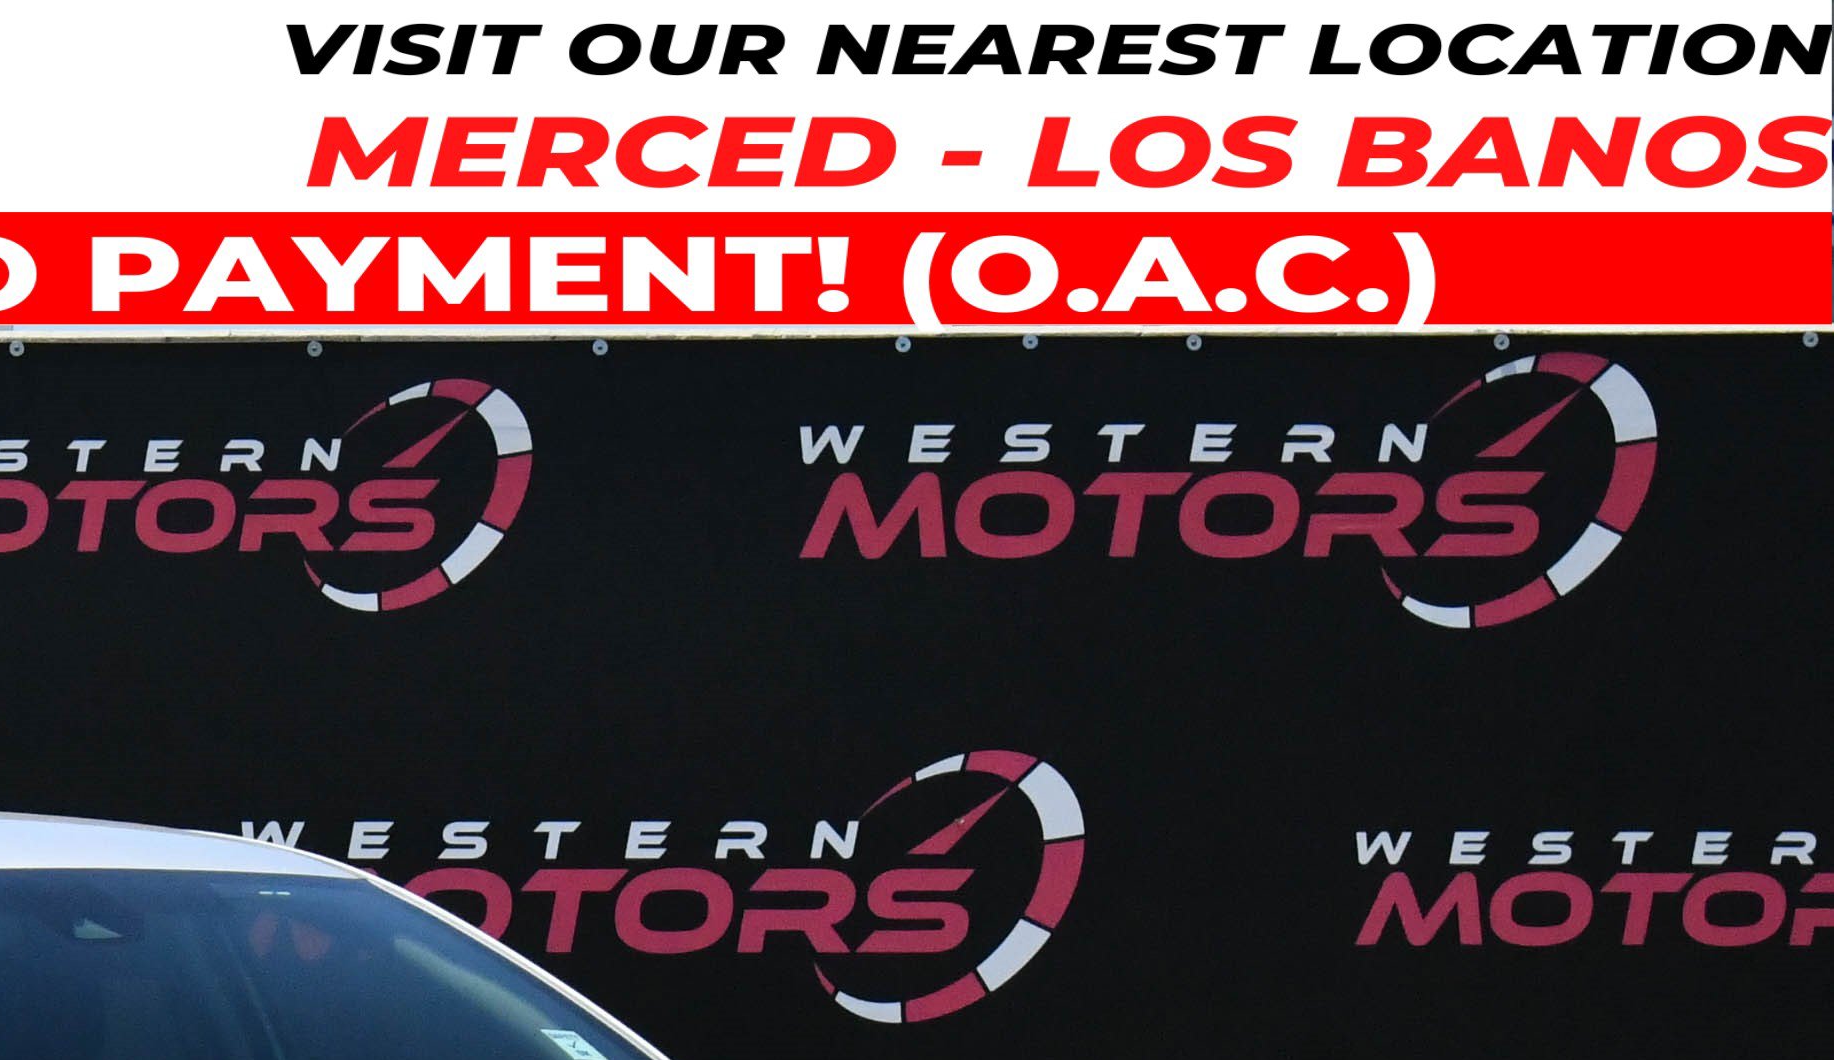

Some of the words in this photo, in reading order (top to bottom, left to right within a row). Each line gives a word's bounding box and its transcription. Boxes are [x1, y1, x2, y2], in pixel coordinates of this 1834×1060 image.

[800, 424, 1428, 464] WESTERN
[799, 471, 1546, 560] MOTORS
[241, 821, 859, 859] WESTERN
[366, 868, 974, 954] OTORS
